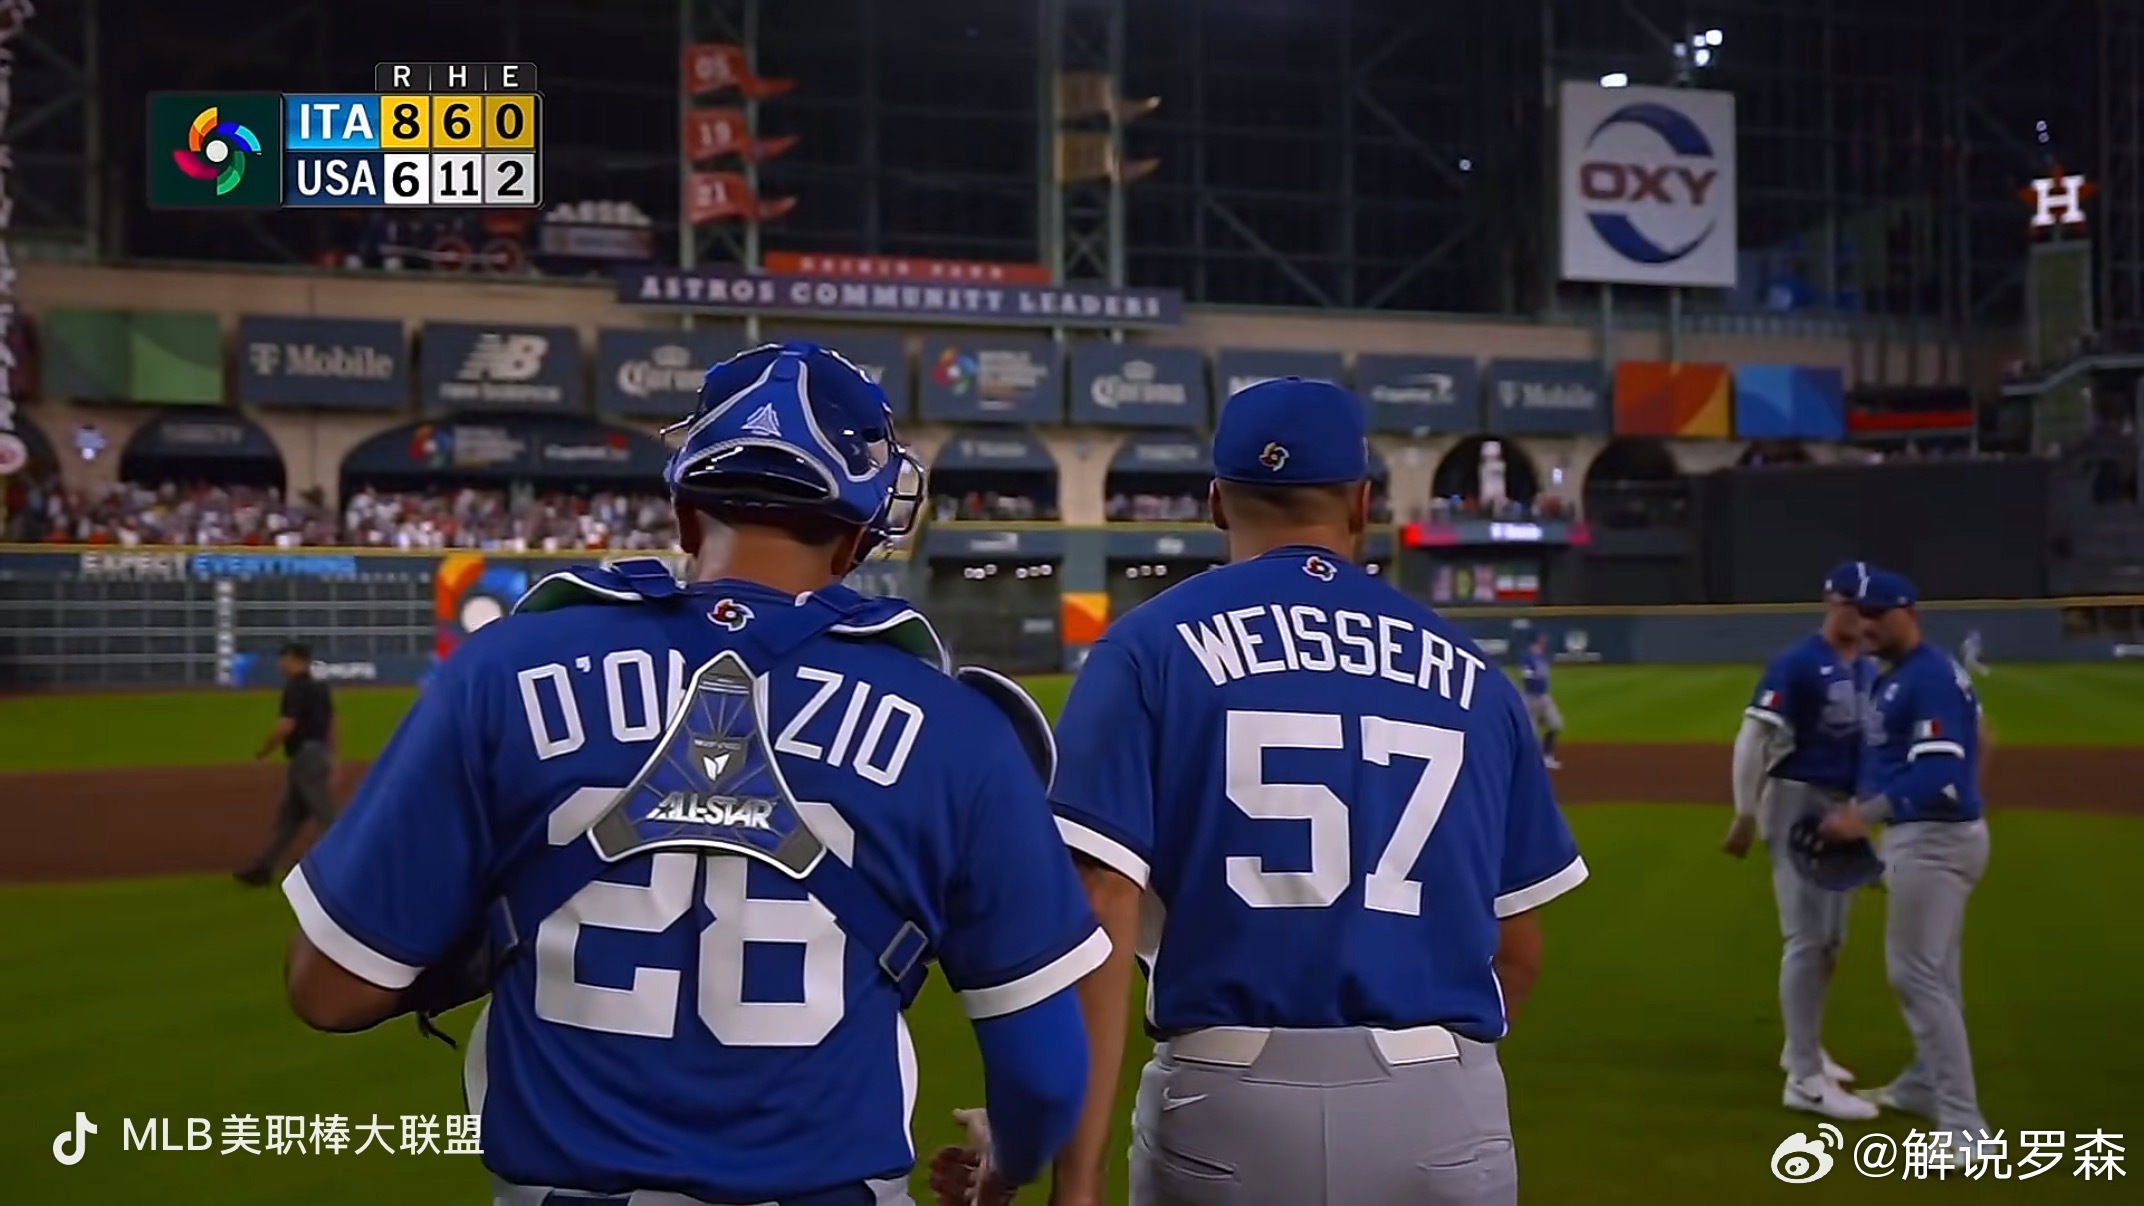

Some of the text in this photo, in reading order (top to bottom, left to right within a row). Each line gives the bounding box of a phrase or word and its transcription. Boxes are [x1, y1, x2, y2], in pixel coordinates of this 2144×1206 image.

[1579, 161, 1718, 207] OXY
[2031, 174, 2086, 226] H
[640, 275, 1161, 318] ASTROS COMMUNITY LEADERS
[285, 343, 394, 381] Mobile
[1176, 604, 1486, 711] WEISSERT
[646, 790, 776, 830] ALL-STAR
[1225, 709, 1466, 917] 57
[534, 786, 855, 1046] 26
